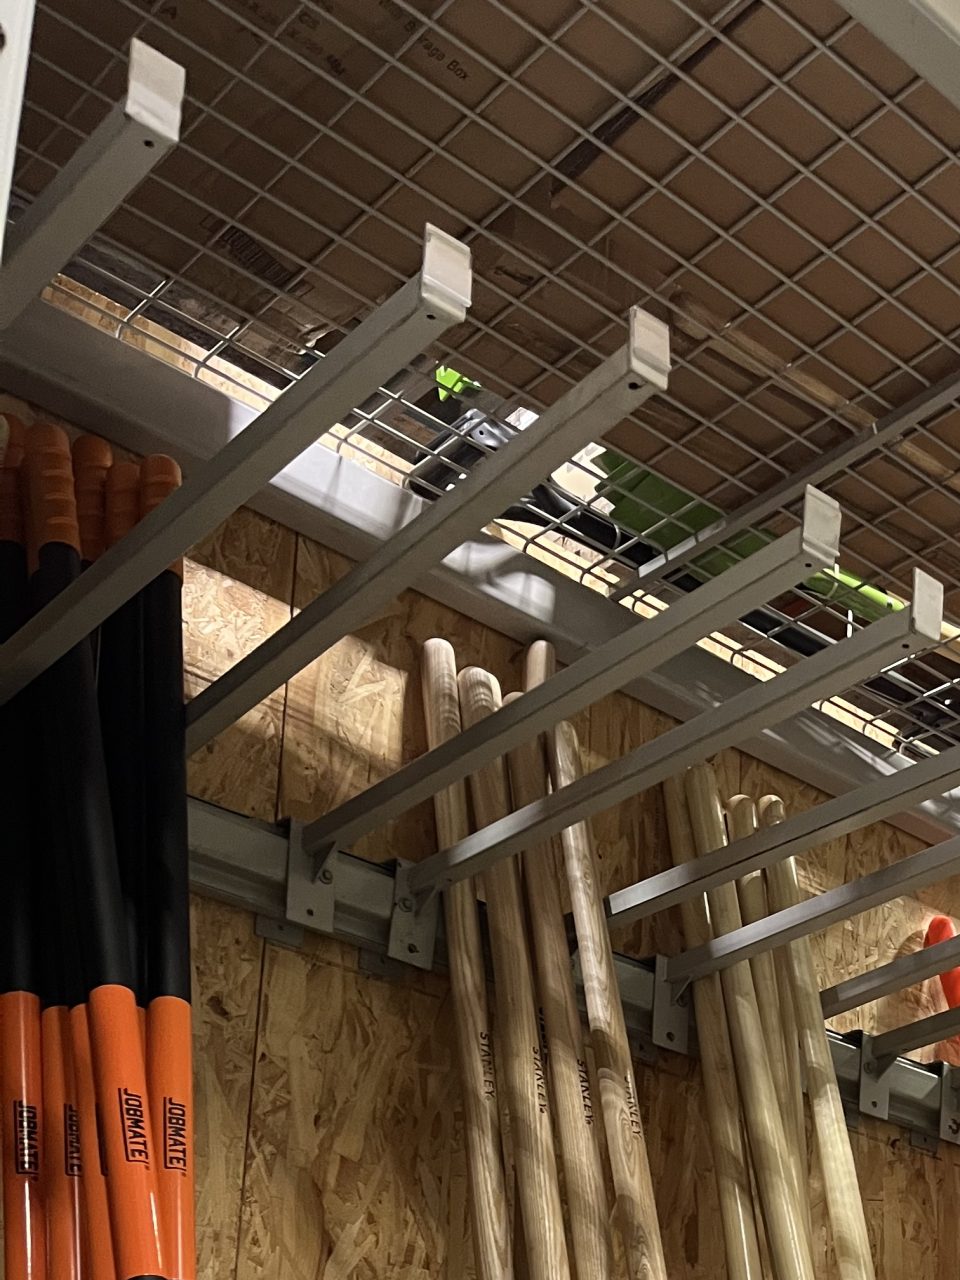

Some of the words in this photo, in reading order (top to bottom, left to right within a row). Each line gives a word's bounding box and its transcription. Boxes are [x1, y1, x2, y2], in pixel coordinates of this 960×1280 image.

[446, 58, 470, 81] Box
[480, 1032, 496, 1098] STANLEY
[533, 1046, 548, 1111] STANLEY
[577, 1059, 594, 1123] STANLEY
[18, 1101, 38, 1174] JOBMATE
[124, 1088, 149, 1161] JOBMATE
[168, 1097, 187, 1169] JOBMATE
